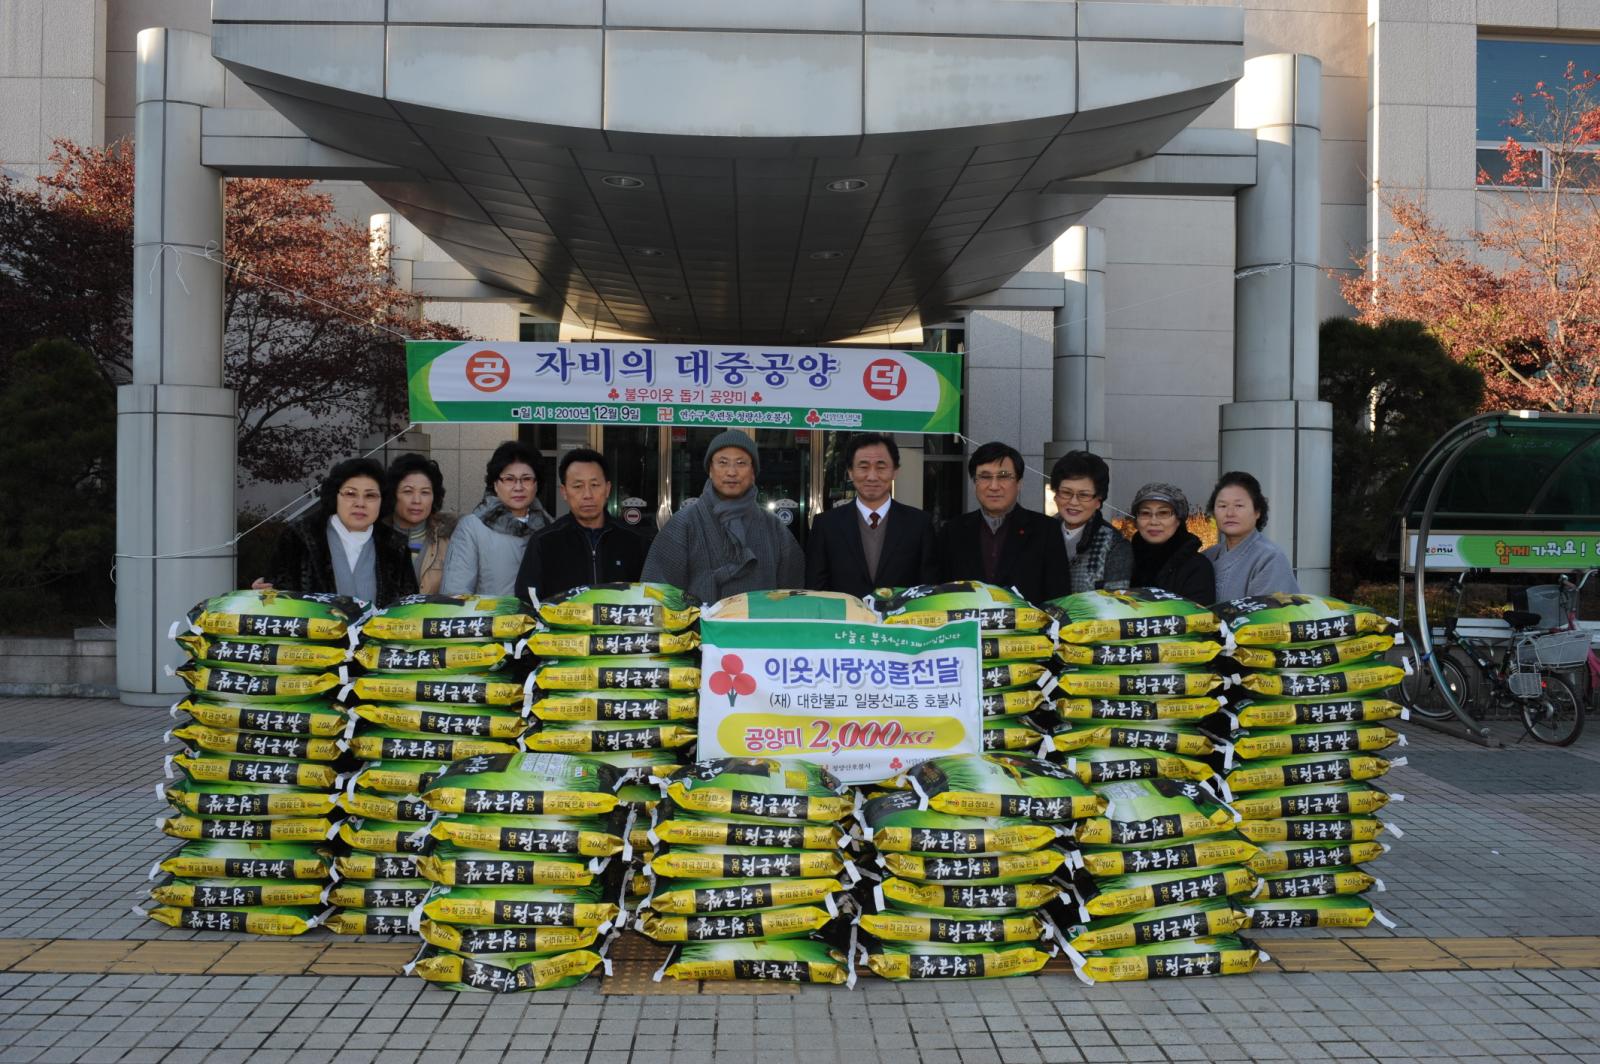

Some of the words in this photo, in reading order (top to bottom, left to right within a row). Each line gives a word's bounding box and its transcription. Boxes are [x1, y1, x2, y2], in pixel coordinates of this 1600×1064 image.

[477, 357, 500, 387] 공
[534, 348, 656, 385] 자비의
[677, 351, 841, 390] 대중공양
[869, 364, 900, 396] 덕
[624, 388, 674, 404] 불우이웃
[680, 388, 705, 404] 돕기
[709, 390, 747, 405] 공양미
[555, 408, 589, 419] 2010년
[595, 408, 618, 419] 12월
[621, 408, 639, 420] 9일
[1495, 540, 1530, 565] 함께
[610, 606, 655, 626] 청금쌀
[254, 617, 300, 636] 청금쌀
[439, 617, 485, 637] 청금쌀
[1136, 616, 1179, 637] 청금쌀
[1306, 617, 1348, 639] 청금쌀
[605, 634, 653, 653] 청금쌀
[835, 631, 865, 644] 나눔은
[216, 642, 262, 662] 청금쌀
[387, 650, 431, 667] 청금쌀
[1101, 646, 1143, 664] 청금쌀
[1283, 650, 1322, 668] 청금쌀
[615, 669, 661, 689] 청금쌀
[765, 656, 960, 685] 이웃사랑성품전달
[216, 671, 259, 691] 청금쌀
[1135, 675, 1178, 694] 청금쌀
[1291, 676, 1330, 695] 청금쌀
[433, 683, 478, 703] 청금쌀
[770, 693, 790, 708] (재)
[798, 693, 848, 708] 대한불교
[855, 693, 918, 710] 일붕선교종
[925, 692, 961, 708] 호불사
[613, 700, 660, 719] 청금쌀
[1100, 701, 1143, 718] 청금쌀
[1312, 703, 1355, 722] 청금쌀
[256, 712, 302, 733] 청금쌀
[437, 715, 482, 735] 청금쌀
[253, 737, 300, 757] 청금쌀
[390, 739, 437, 757] 청금쌀
[607, 728, 653, 749] 청금쌀
[744, 728, 802, 750] 공양미
[1126, 731, 1170, 750] 청금쌀
[1308, 732, 1351, 752] 청금쌀
[245, 763, 290, 783] 청금쌀
[1099, 761, 1143, 781] 청금쌀
[1300, 761, 1343, 781] 청금쌀
[206, 795, 249, 814] 청금쌀
[474, 790, 525, 813] 청금쌀
[750, 795, 799, 816] 청금쌀
[1018, 798, 1064, 819] 청금쌀
[1298, 795, 1341, 814] 청금쌀
[209, 820, 254, 839] 청금쌀
[745, 827, 795, 847] 청금쌀
[1120, 818, 1164, 843] 청금쌀
[1302, 821, 1345, 839] 청금쌀
[519, 830, 568, 853] 청금쌀
[921, 830, 967, 852] 청금쌀
[742, 855, 792, 876] 청금쌀
[1133, 850, 1179, 872] 청금쌀
[1302, 848, 1344, 867] 청금쌀
[242, 861, 286, 878] 청금쌀
[464, 861, 514, 884] 청금쌀
[935, 858, 981, 879] 청금쌀
[1171, 876, 1217, 902] 청금쌀
[1284, 875, 1328, 896] 청금쌀
[201, 888, 245, 906] 청금쌀
[373, 891, 418, 907] 청금쌀
[705, 887, 753, 908] 청금쌀
[962, 886, 1008, 907] 청금쌀
[188, 911, 231, 930] 청금쌀
[514, 903, 564, 925] 청금쌀
[1259, 912, 1302, 928] 청금쌀
[696, 917, 744, 939] 청금쌀
[948, 921, 996, 942] 청금쌀
[1153, 916, 1200, 941] 청금쌀
[470, 930, 517, 952] 청금쌀
[753, 962, 803, 981] 청금쌀
[920, 957, 967, 978] 청금쌀
[1166, 955, 1213, 976] 청금쌀
[470, 964, 517, 990] 청금쌀
